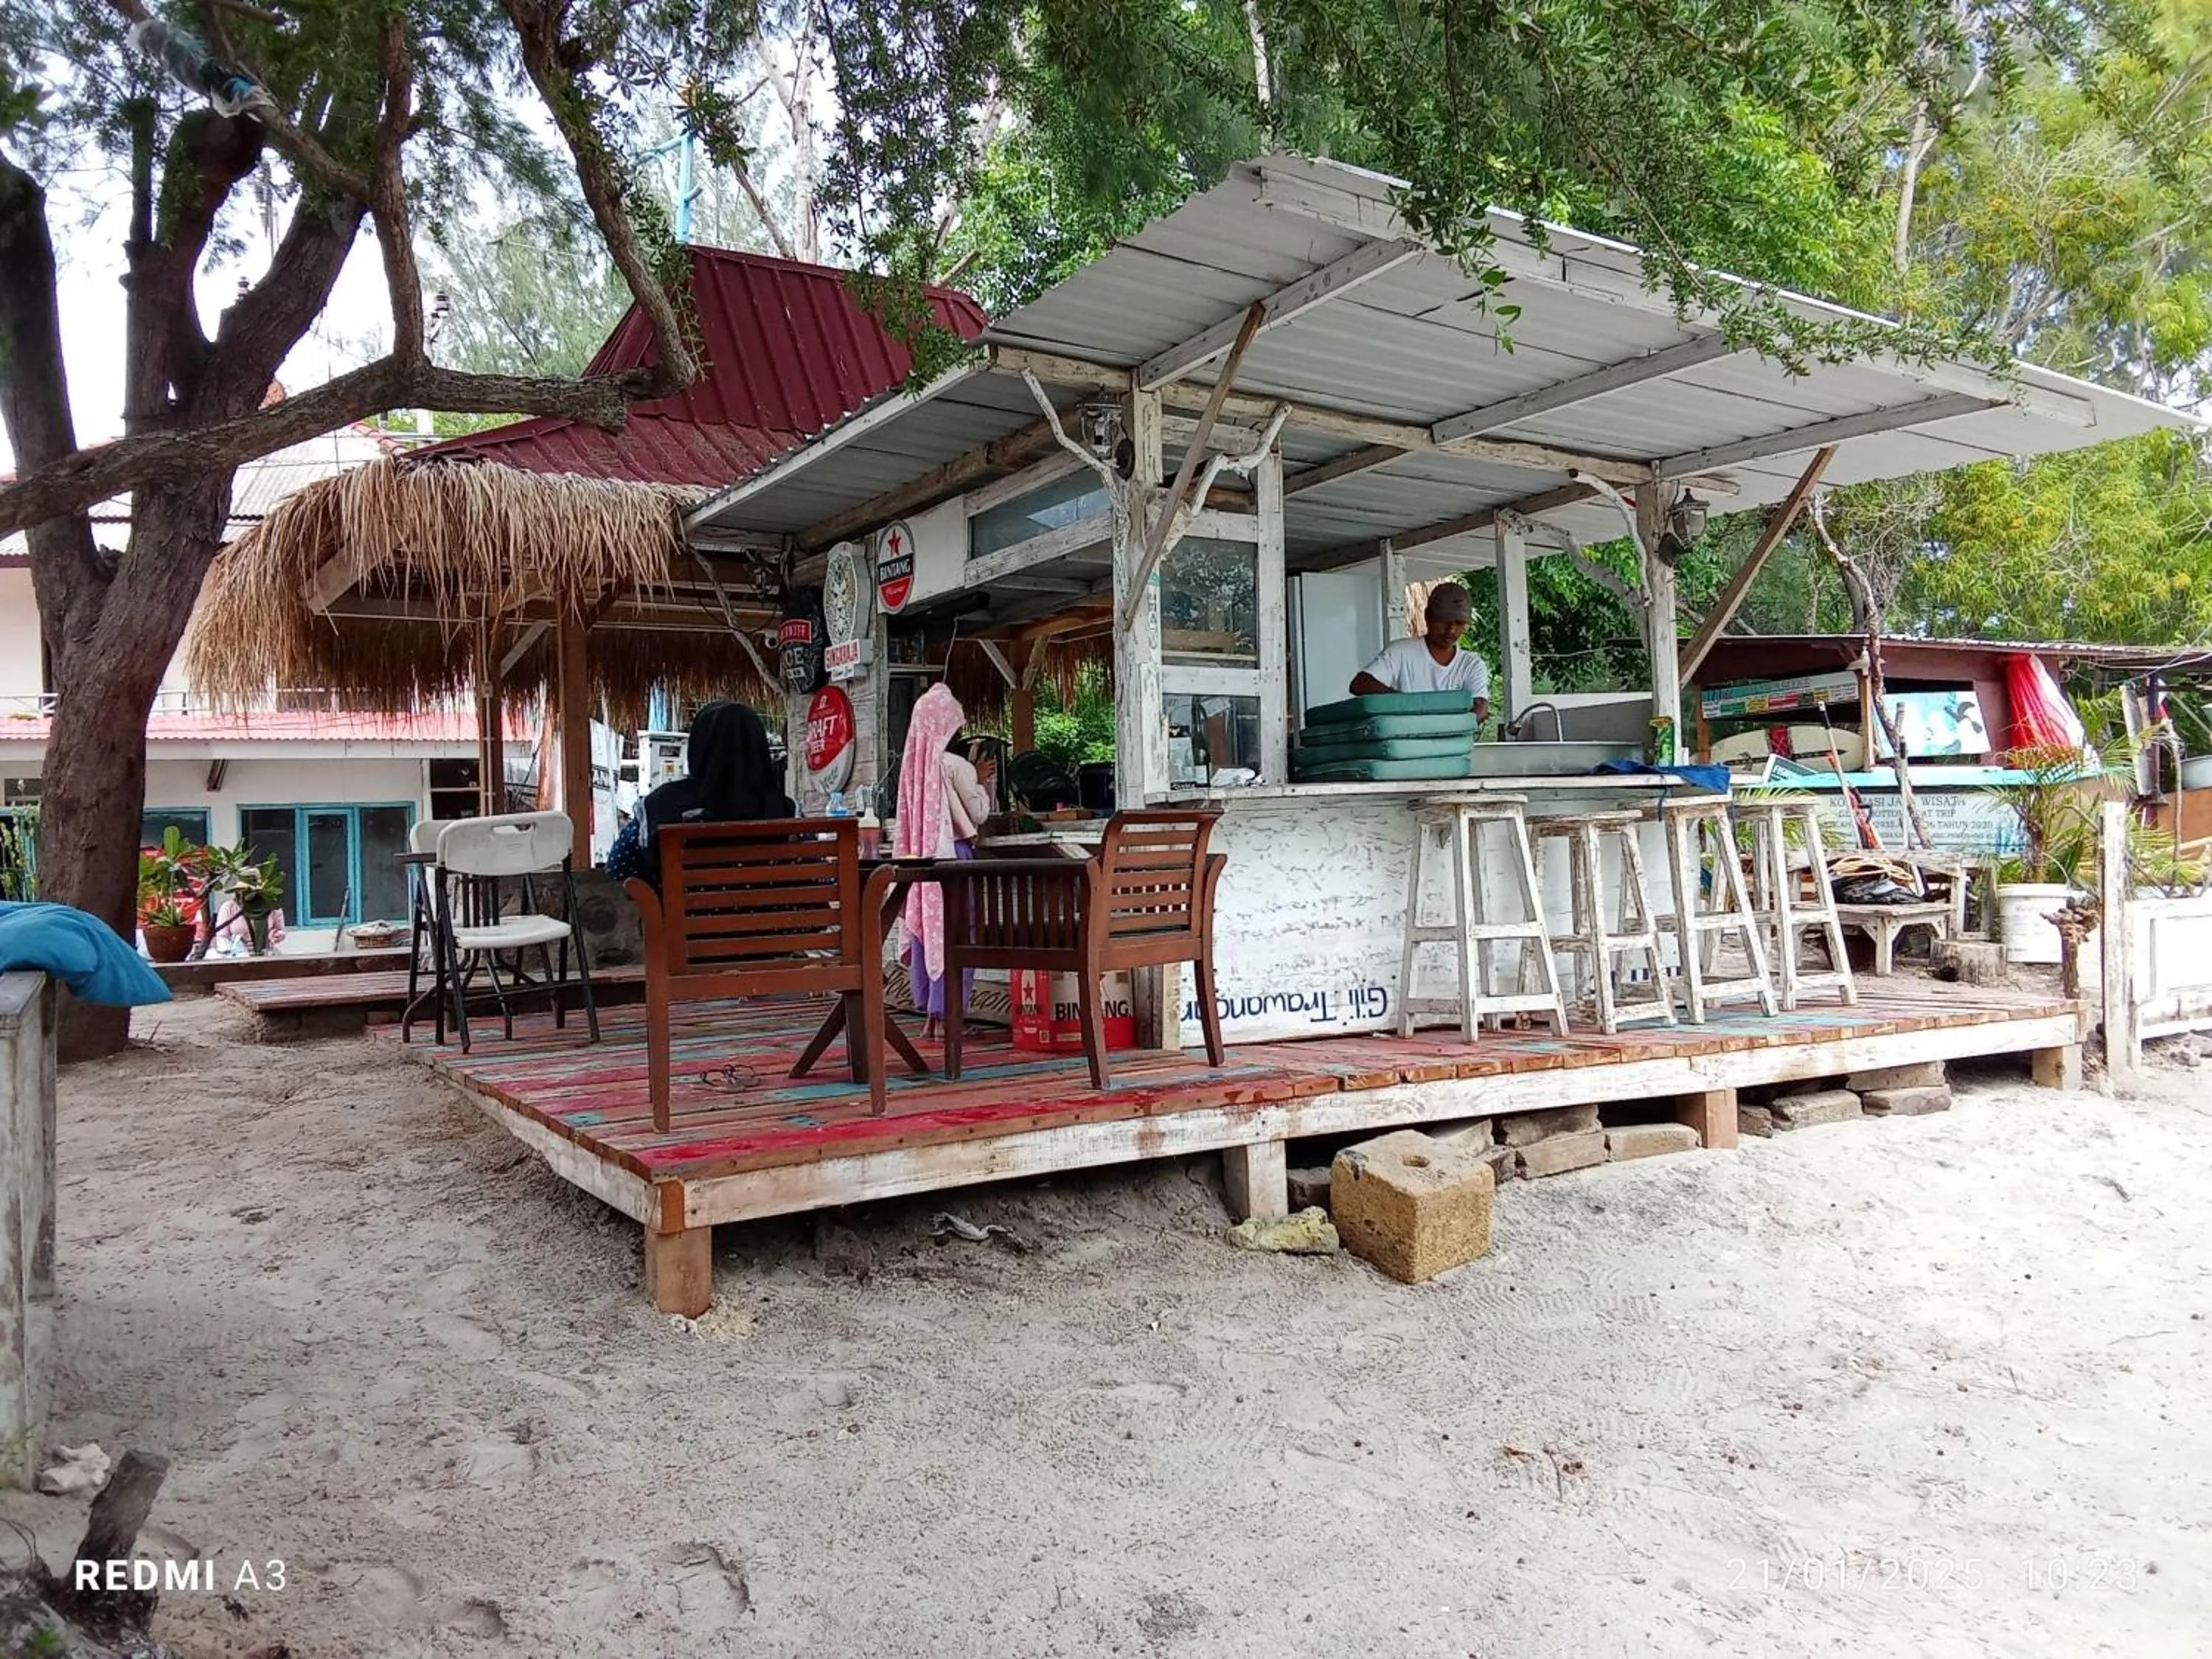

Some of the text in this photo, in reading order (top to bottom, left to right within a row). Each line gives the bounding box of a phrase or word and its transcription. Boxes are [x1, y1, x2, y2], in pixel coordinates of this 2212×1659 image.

[880, 558, 911, 582] BINTANG
[1055, 1000, 1130, 1021] BINNG
[1349, 987, 1388, 1018] Gili
